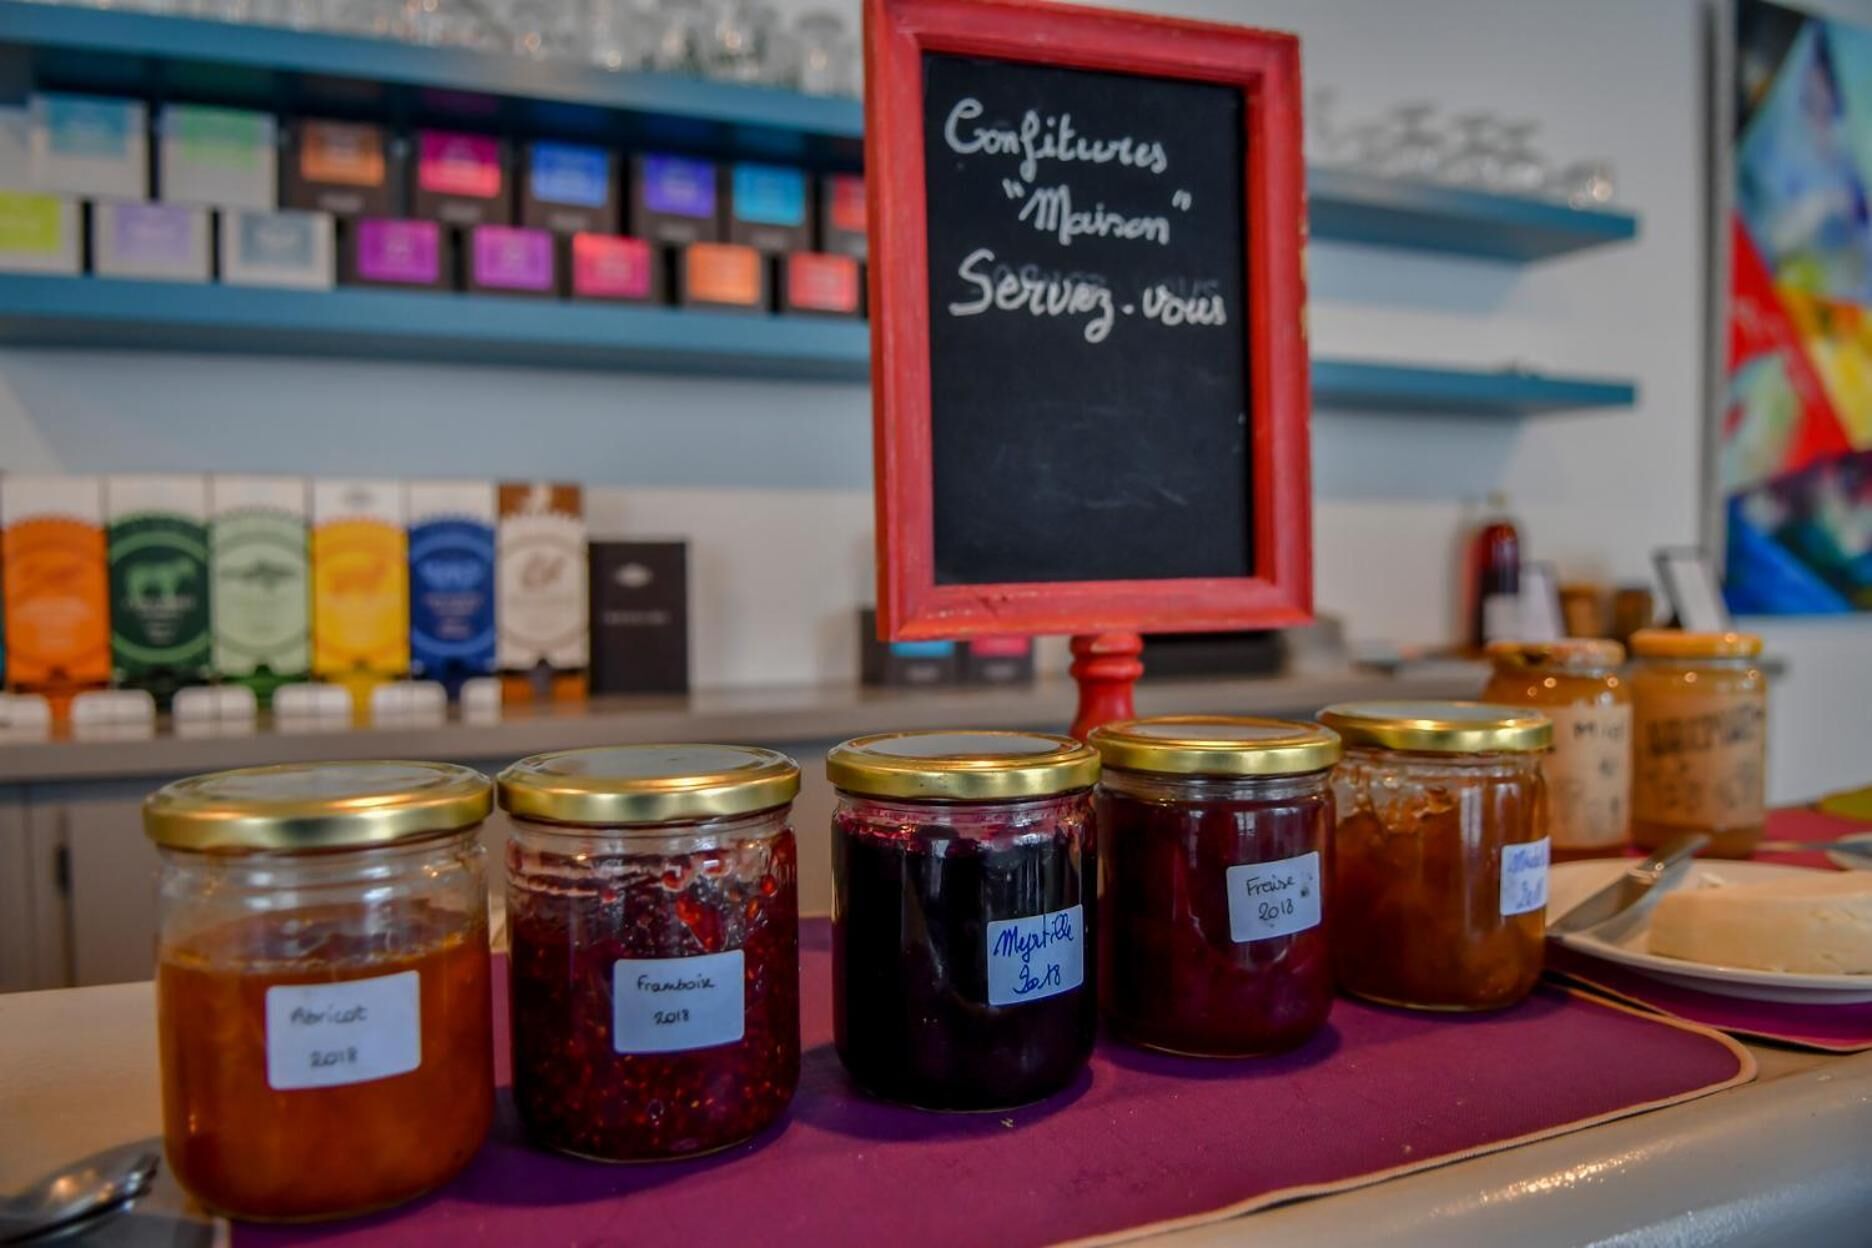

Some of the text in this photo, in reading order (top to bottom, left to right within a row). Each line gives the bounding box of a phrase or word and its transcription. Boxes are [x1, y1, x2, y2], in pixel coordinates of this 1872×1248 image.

[944, 97, 1167, 182] Confitures
[1246, 874, 1295, 896] Fraise
[1258, 898, 1294, 920] 2018
[993, 912, 1074, 962] Myrtille
[1013, 963, 1061, 993] 2018
[290, 1004, 368, 1025] Abricot
[654, 1009, 689, 1024] 2018
[310, 1047, 358, 1068] 2018
